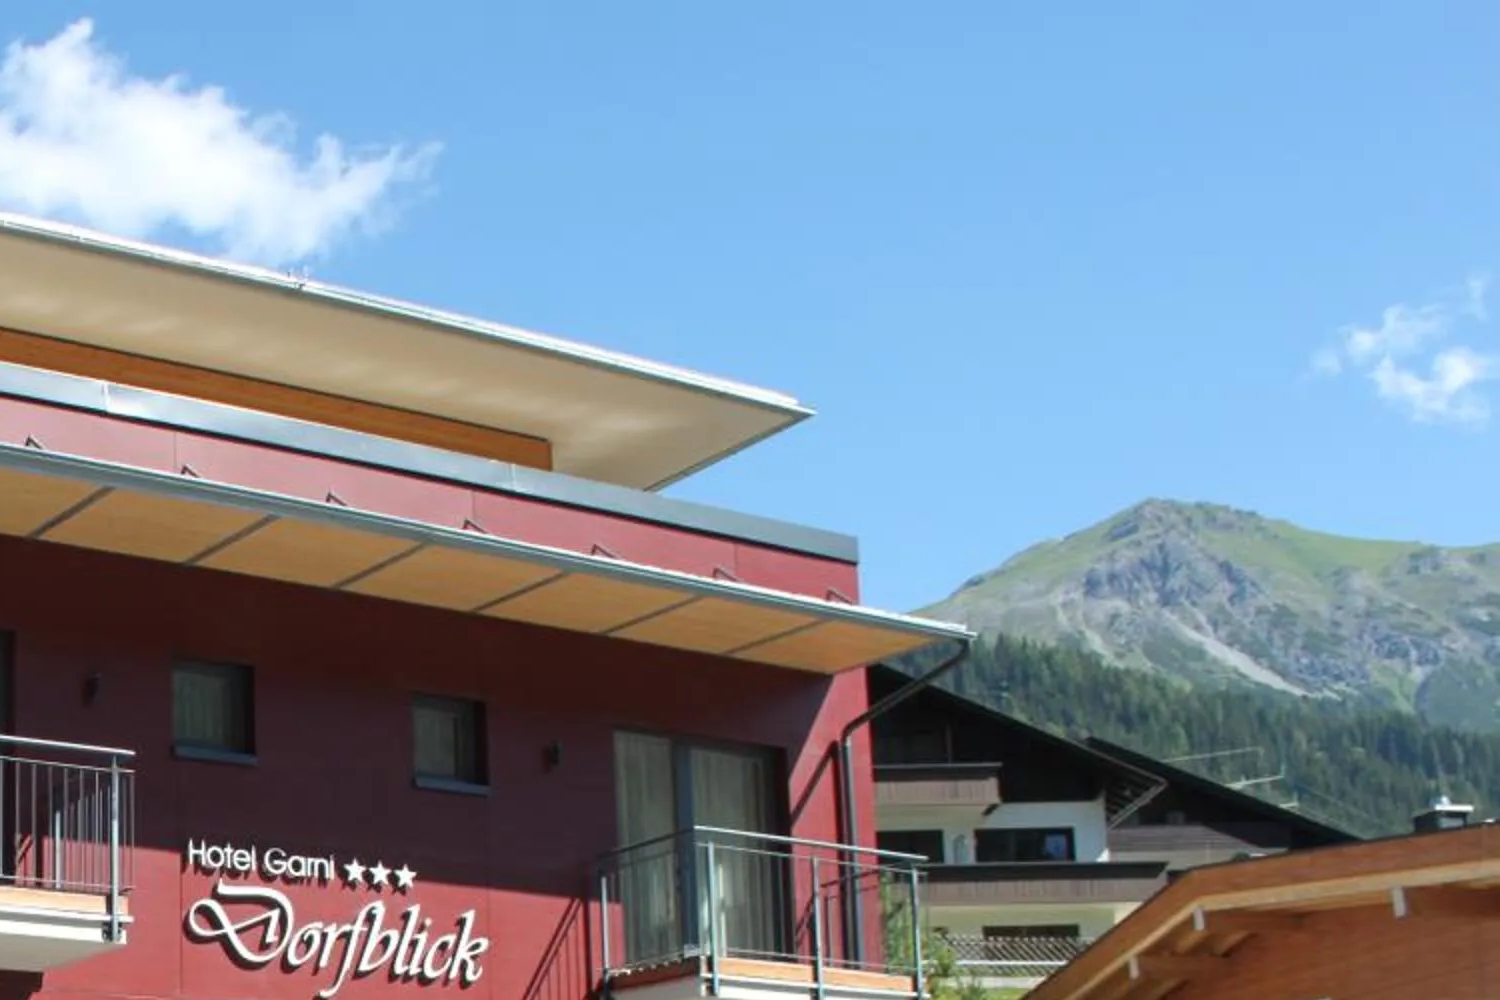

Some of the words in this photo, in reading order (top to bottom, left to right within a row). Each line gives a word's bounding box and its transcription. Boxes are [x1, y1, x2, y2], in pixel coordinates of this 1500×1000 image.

[188, 838, 256, 871] Hotel
[264, 847, 334, 880] Garni
[189, 878, 489, 998] Dorfblick
